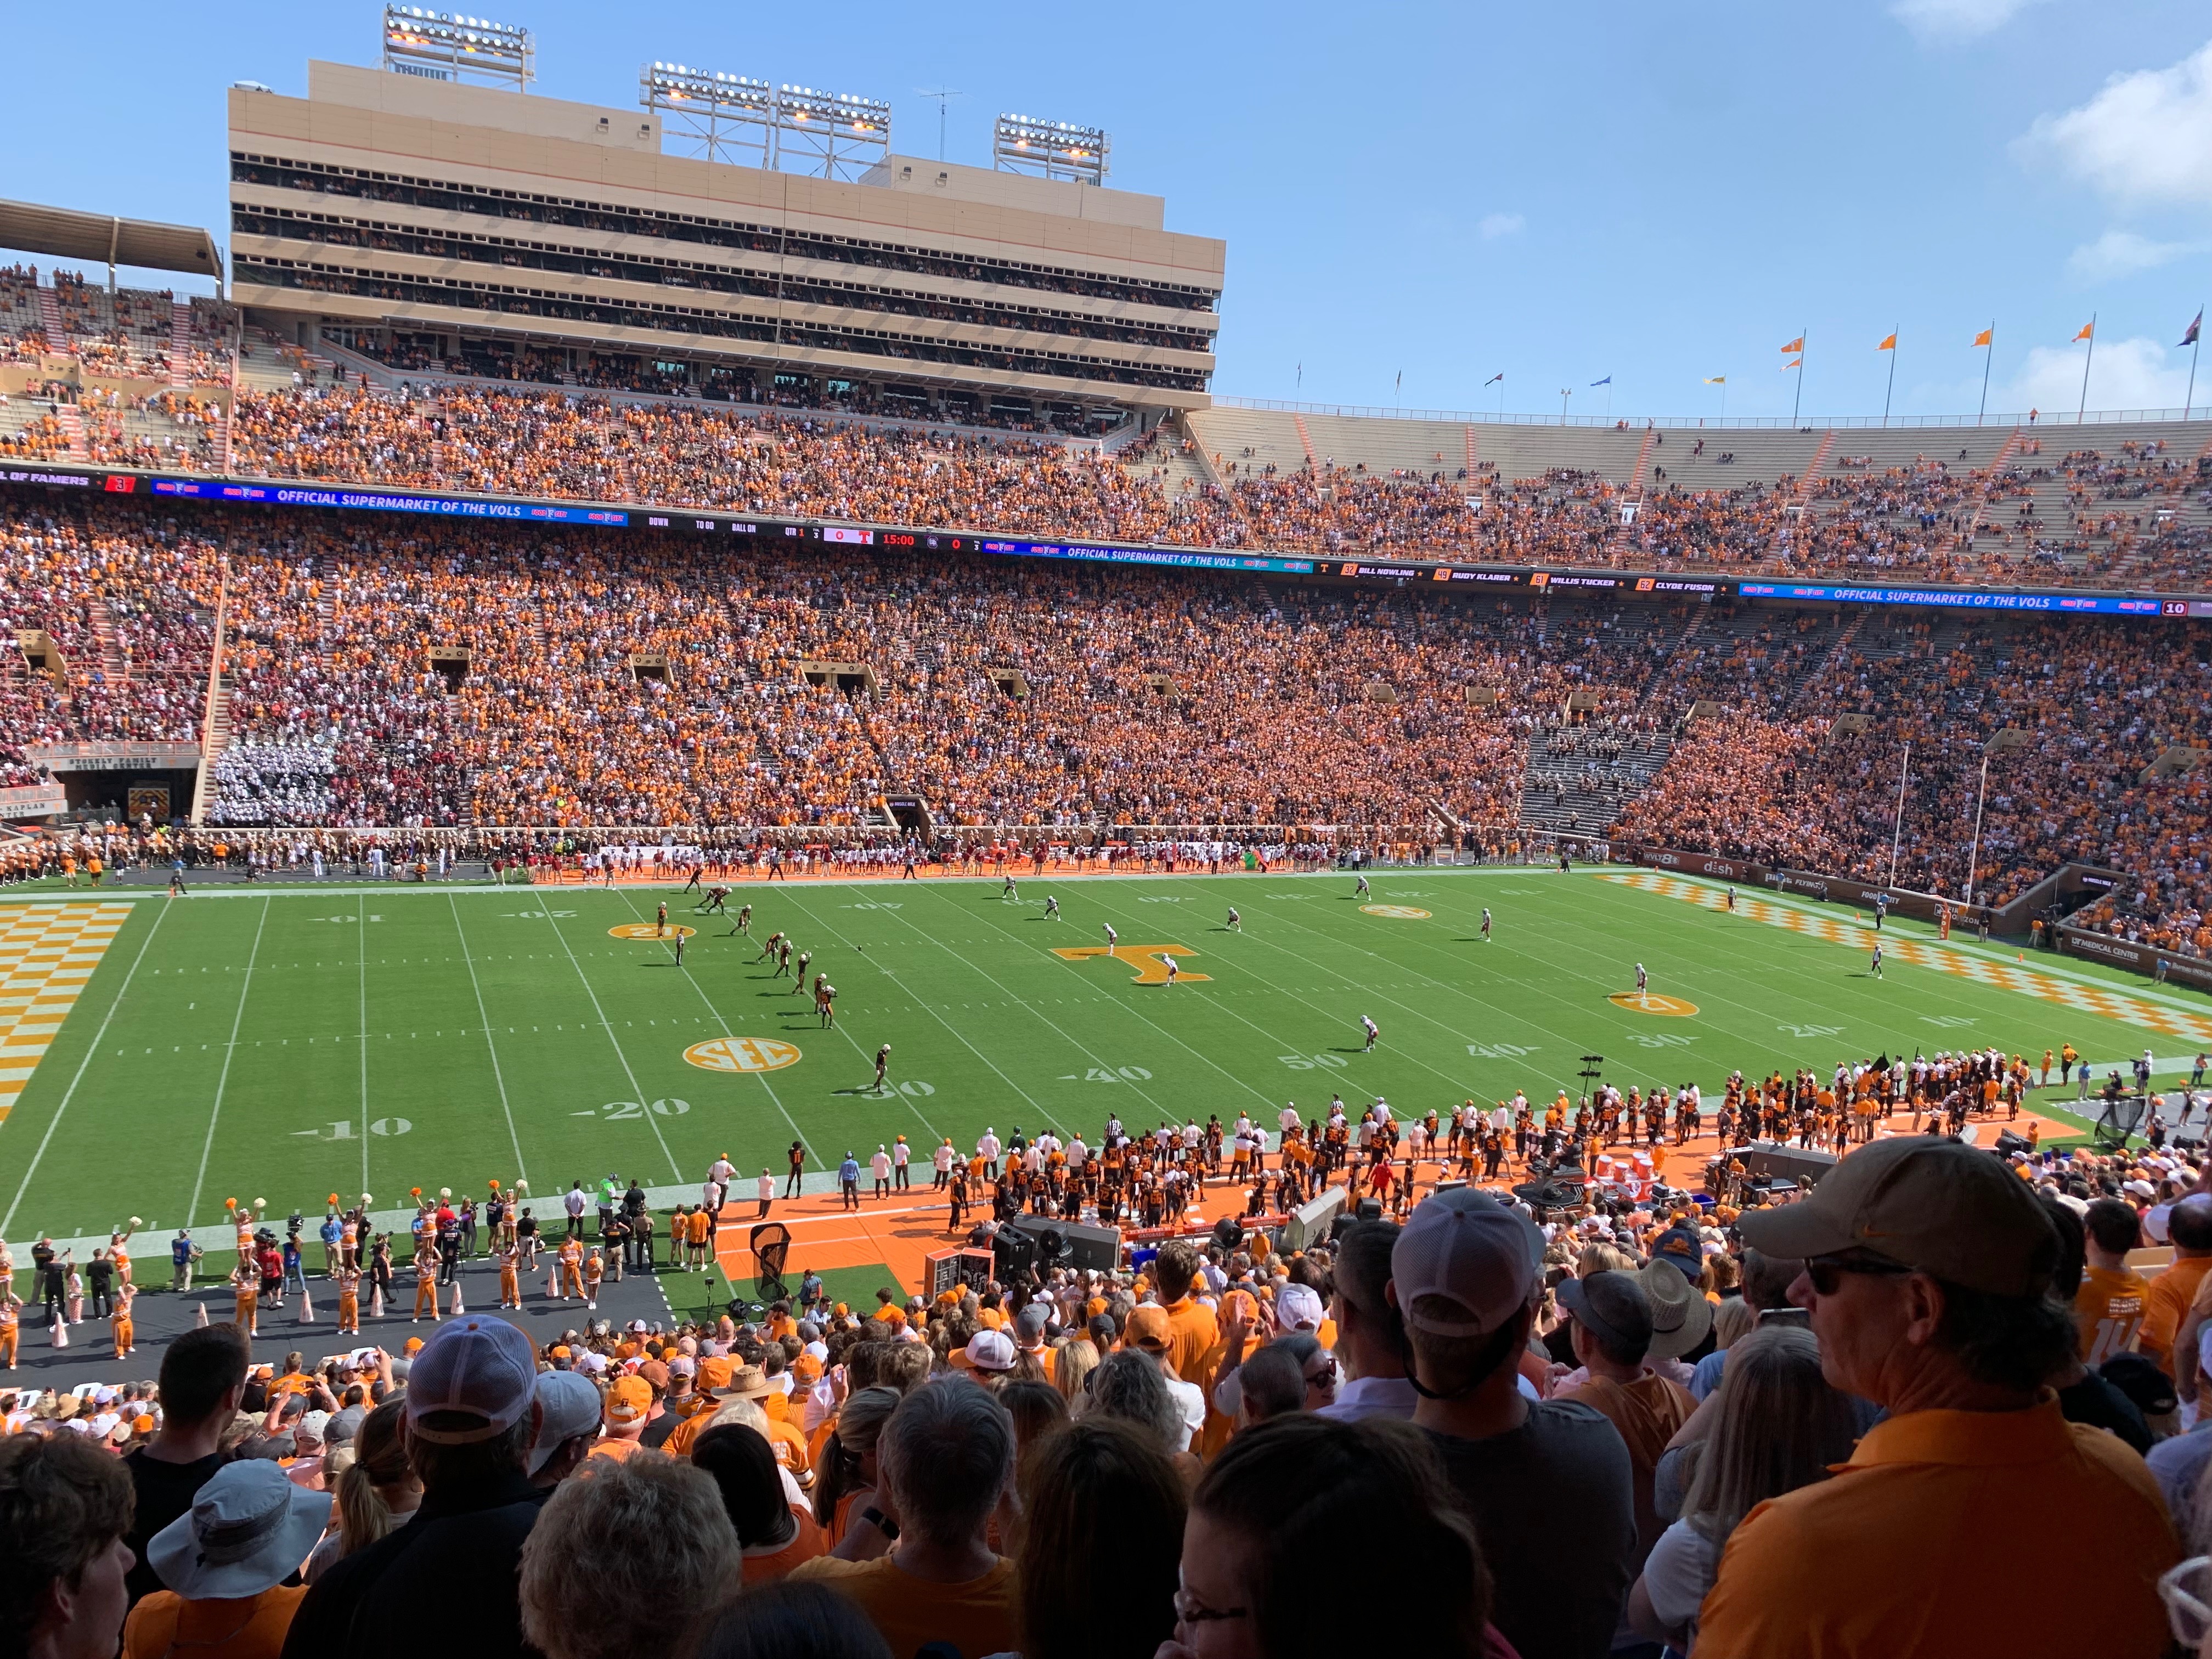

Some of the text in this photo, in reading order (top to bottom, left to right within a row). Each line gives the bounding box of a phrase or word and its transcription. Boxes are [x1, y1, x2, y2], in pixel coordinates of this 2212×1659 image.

[10, 472, 29, 481] OF
[30, 473, 89, 486] FAMERS
[116, 478, 124, 489] 3
[277, 490, 521, 517] OFFICIAL SUPERMARKET OF THE VOLS
[649, 517, 668, 527] DOWN
[696, 520, 714, 529] TO GO
[732, 523, 756, 533] BALL ON
[785, 527, 804, 537] QTR 1
[883, 534, 914, 546] 15:00
[1068, 548, 1236, 567] OFFICIAL SUPERMARKET OF THE VOLS
[1345, 566, 1354, 574] 32
[1377, 568, 1415, 577] NOWLING
[1438, 571, 1447, 579] 49
[1536, 575, 1615, 586] 61 WILLIS TUCKER
[1640, 580, 1650, 589] 62
[1834, 589, 2050, 607] OFFICIAL SUPERMARKET OF THE VOLS
[2166, 603, 2185, 613] 10
[7, 803, 45, 811] KAPLAN
[1704, 861, 1733, 876] dish
[1861, 890, 1877, 900] FOOD
[2081, 940, 2112, 953] MEDICAL
[2113, 947, 2138, 961] CENTER
[1776, 1024, 1838, 1037] 20
[1626, 1034, 1690, 1047] 30
[692, 1039, 794, 1069] SEC
[1466, 1043, 1527, 1058] 40
[1277, 1054, 1348, 1069] 50
[1084, 1066, 1153, 1083] 40
[855, 1081, 934, 1100] 30
[602, 1098, 690, 1120] 20
[325, 1118, 413, 1141] 10
[794, 1153, 801, 1164] 11
[1017, 1175, 1028, 1184] 78
[1032, 1181, 1044, 1192] 65
